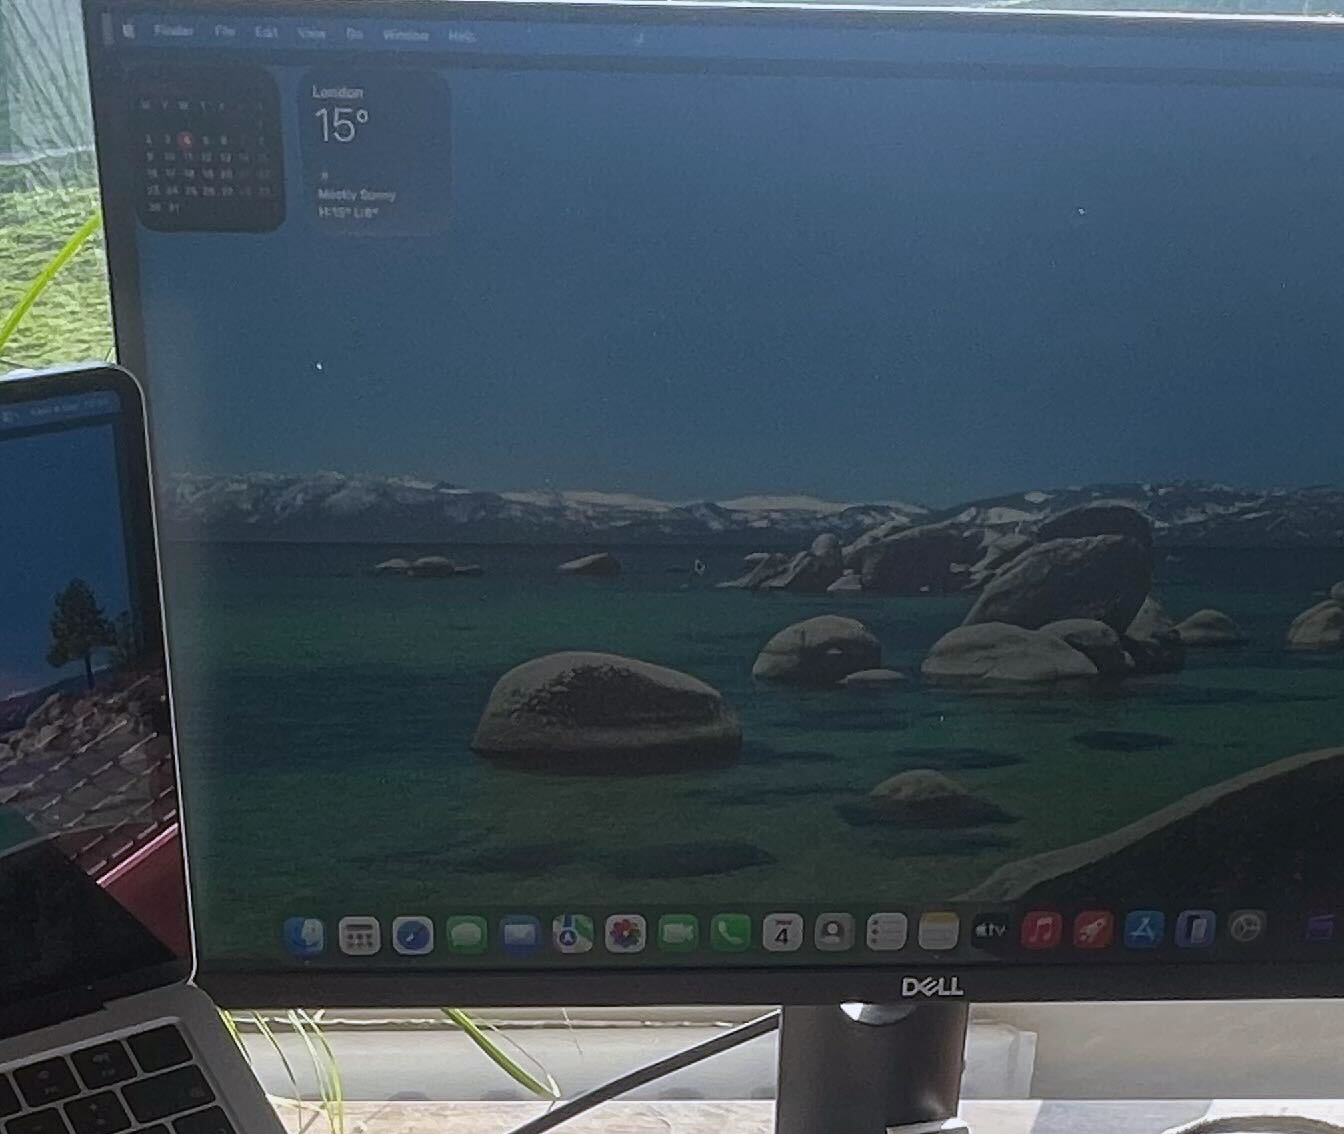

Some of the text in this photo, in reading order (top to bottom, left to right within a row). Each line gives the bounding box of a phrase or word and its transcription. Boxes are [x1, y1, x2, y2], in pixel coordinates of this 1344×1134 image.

[312, 84, 364, 98] London
[774, 928, 788, 944] 4
[902, 977, 964, 997] DELL
